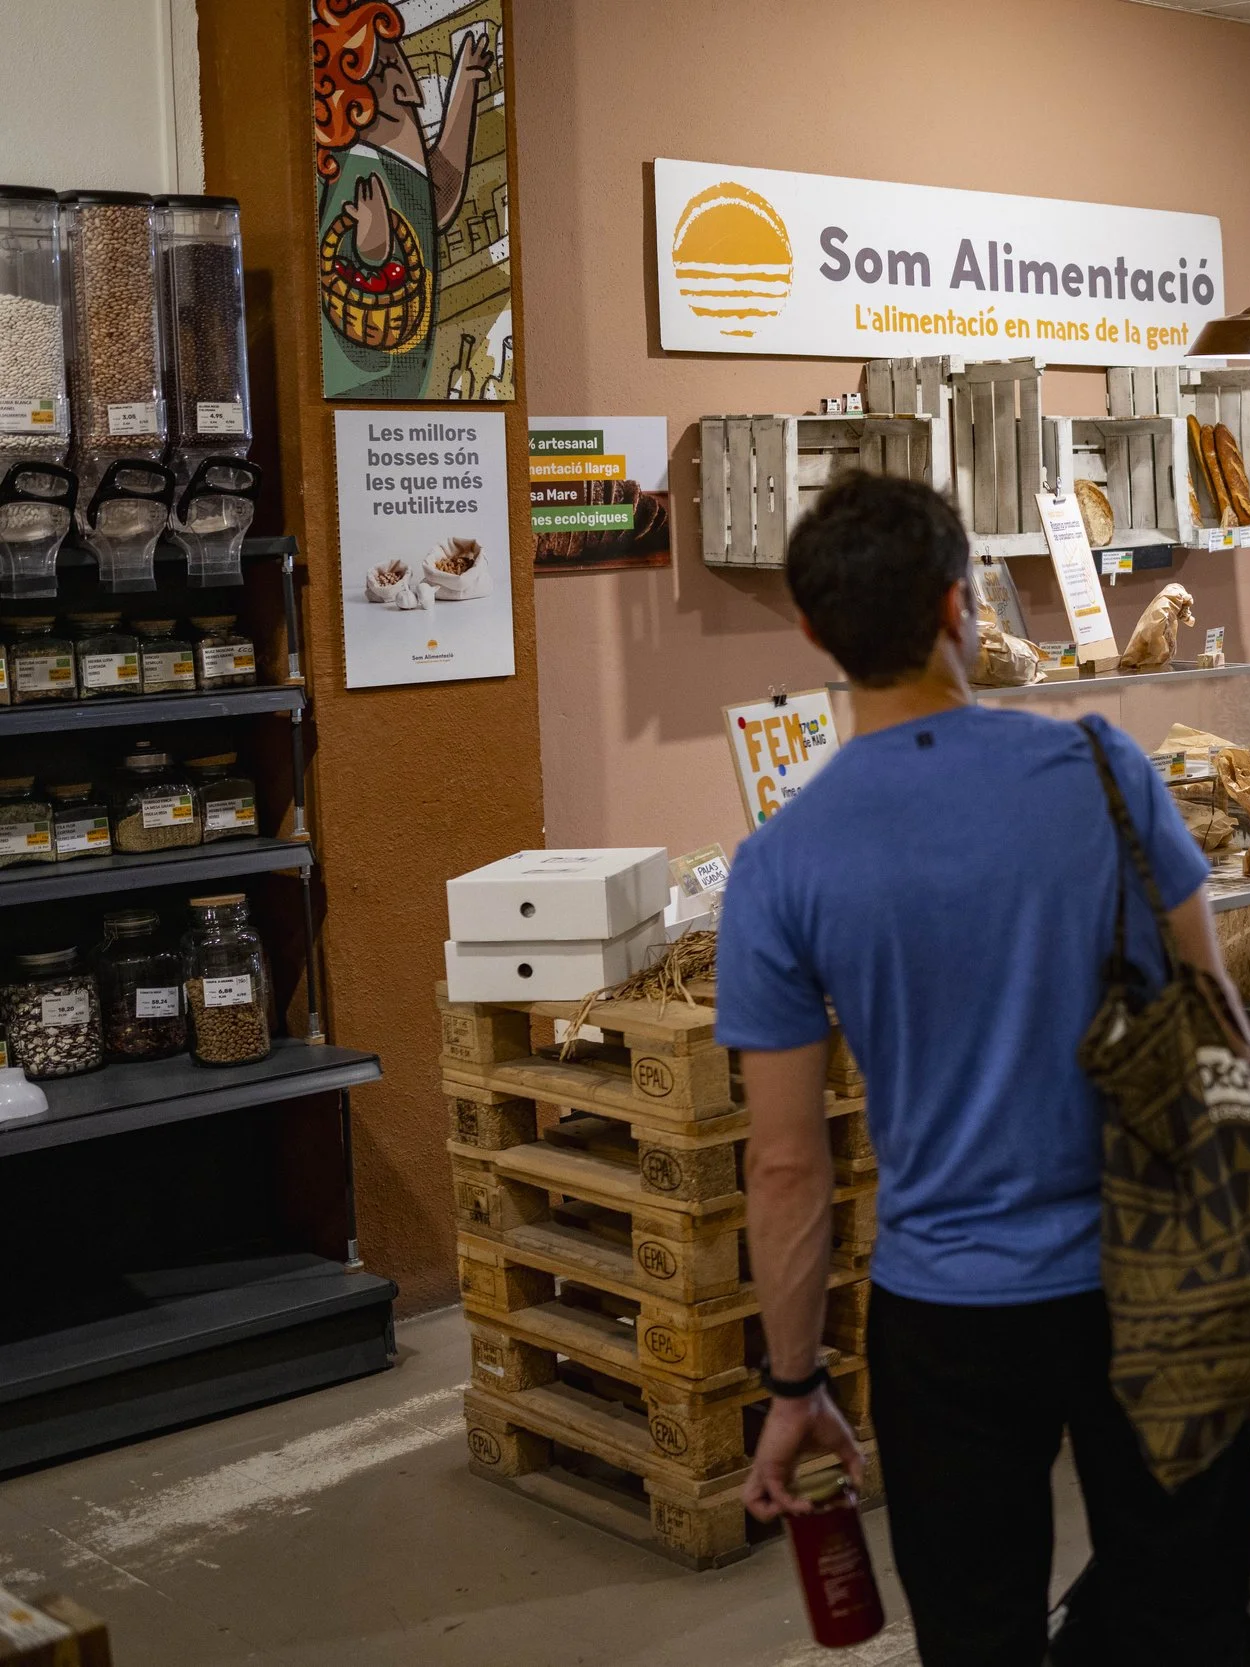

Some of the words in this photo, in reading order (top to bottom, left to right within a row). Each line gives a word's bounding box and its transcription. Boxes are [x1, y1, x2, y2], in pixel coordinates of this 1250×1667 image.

[819, 225, 932, 289] Som
[949, 237, 1215, 306] Alimentació
[854, 303, 999, 337] L'alimentació
[1004, 318, 1031, 338] en
[1036, 317, 1089, 342] mans
[1095, 318, 1120, 343] de
[1124, 318, 1141, 345] la
[1146, 321, 1189, 352] gent
[367, 423, 404, 442] Les
[408, 422, 477, 442] millors
[537, 436, 598, 450] artesanal
[367, 448, 439, 467] bosses
[443, 447, 480, 466] són
[584, 461, 620, 477] llarga
[365, 473, 396, 491] les
[399, 475, 439, 495] que
[442, 470, 483, 489] més
[546, 488, 578, 501] Mare
[373, 495, 478, 516] reutilitzes
[531, 515, 553, 527] nes
[554, 510, 629, 528] ecològiques
[743, 712, 810, 773] FEM
[639, 1064, 669, 1091] EPAL
[643, 1246, 671, 1276] EPAL
[650, 1330, 683, 1359] EPAL
[472, 1433, 497, 1461] EPAL
[654, 1421, 682, 1450] EPAL
